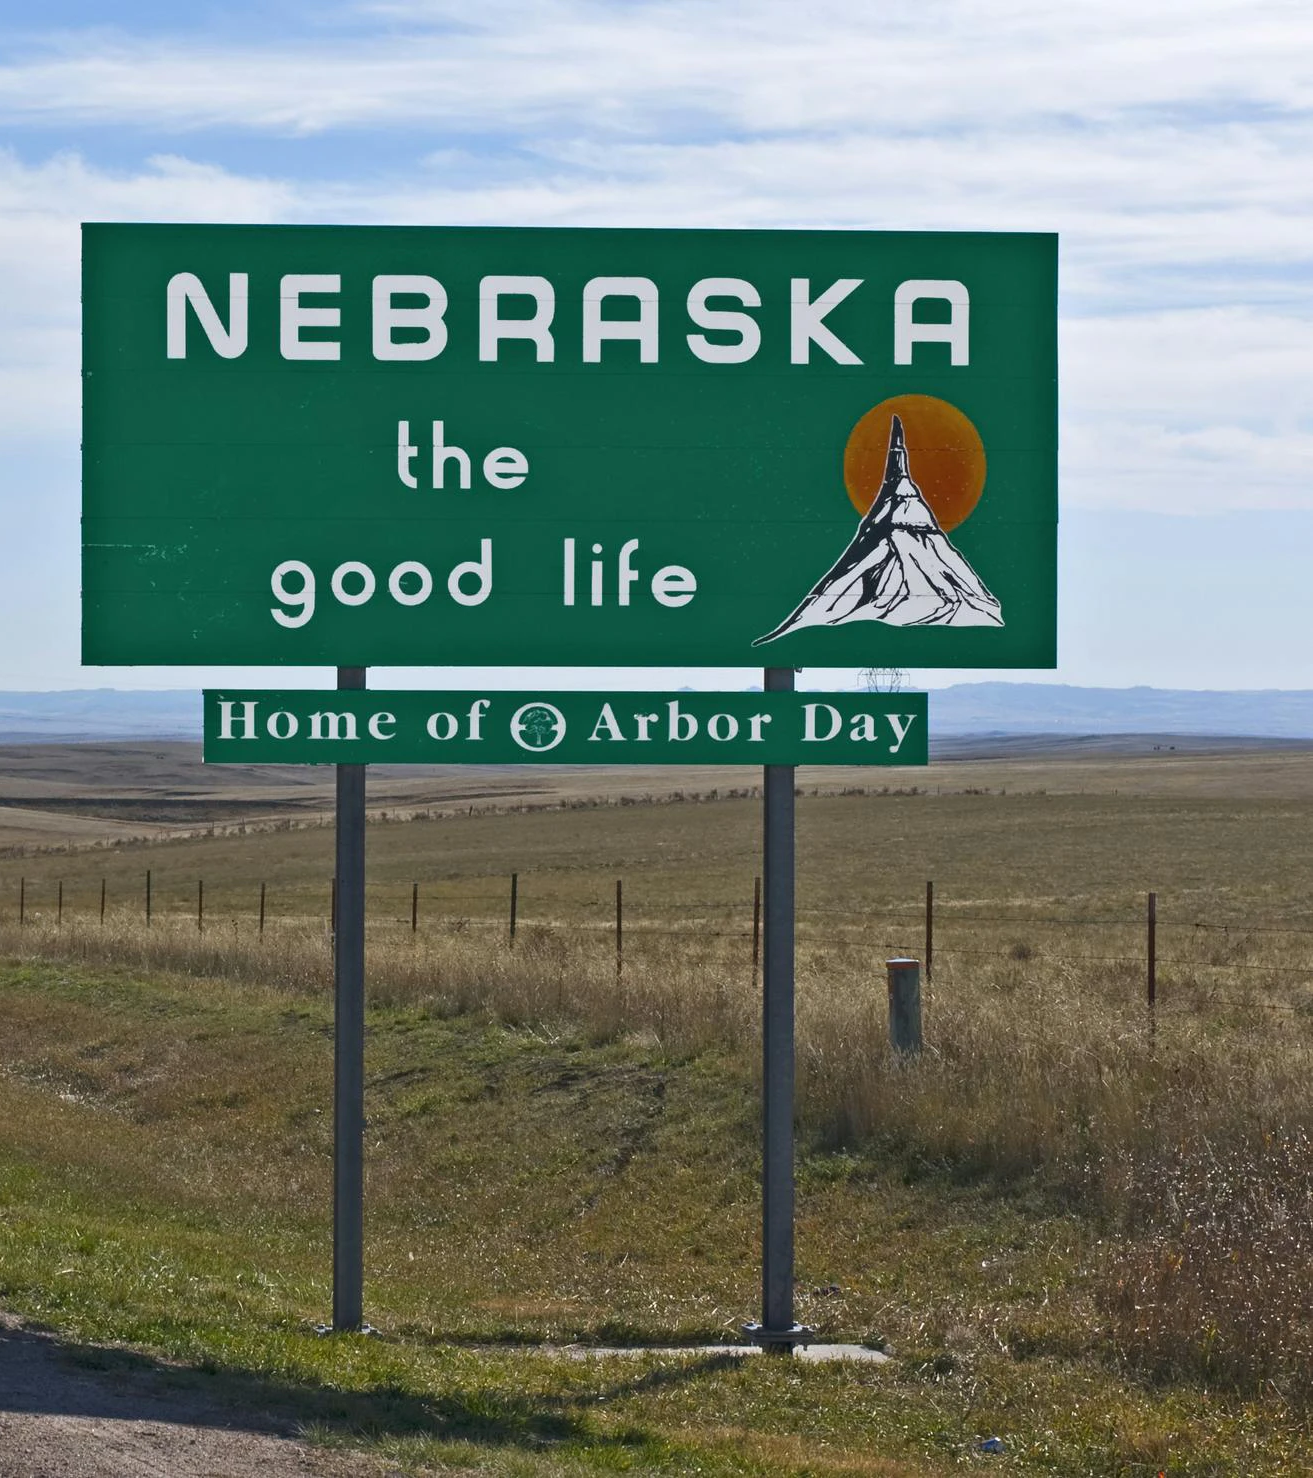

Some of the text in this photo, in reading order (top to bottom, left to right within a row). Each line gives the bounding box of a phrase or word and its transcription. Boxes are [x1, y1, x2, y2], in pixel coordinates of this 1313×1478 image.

[166, 272, 970, 366] NEBRASKA
[397, 420, 529, 490] the
[270, 537, 697, 629] good life
[218, 699, 915, 753] Home of Arbor Day
